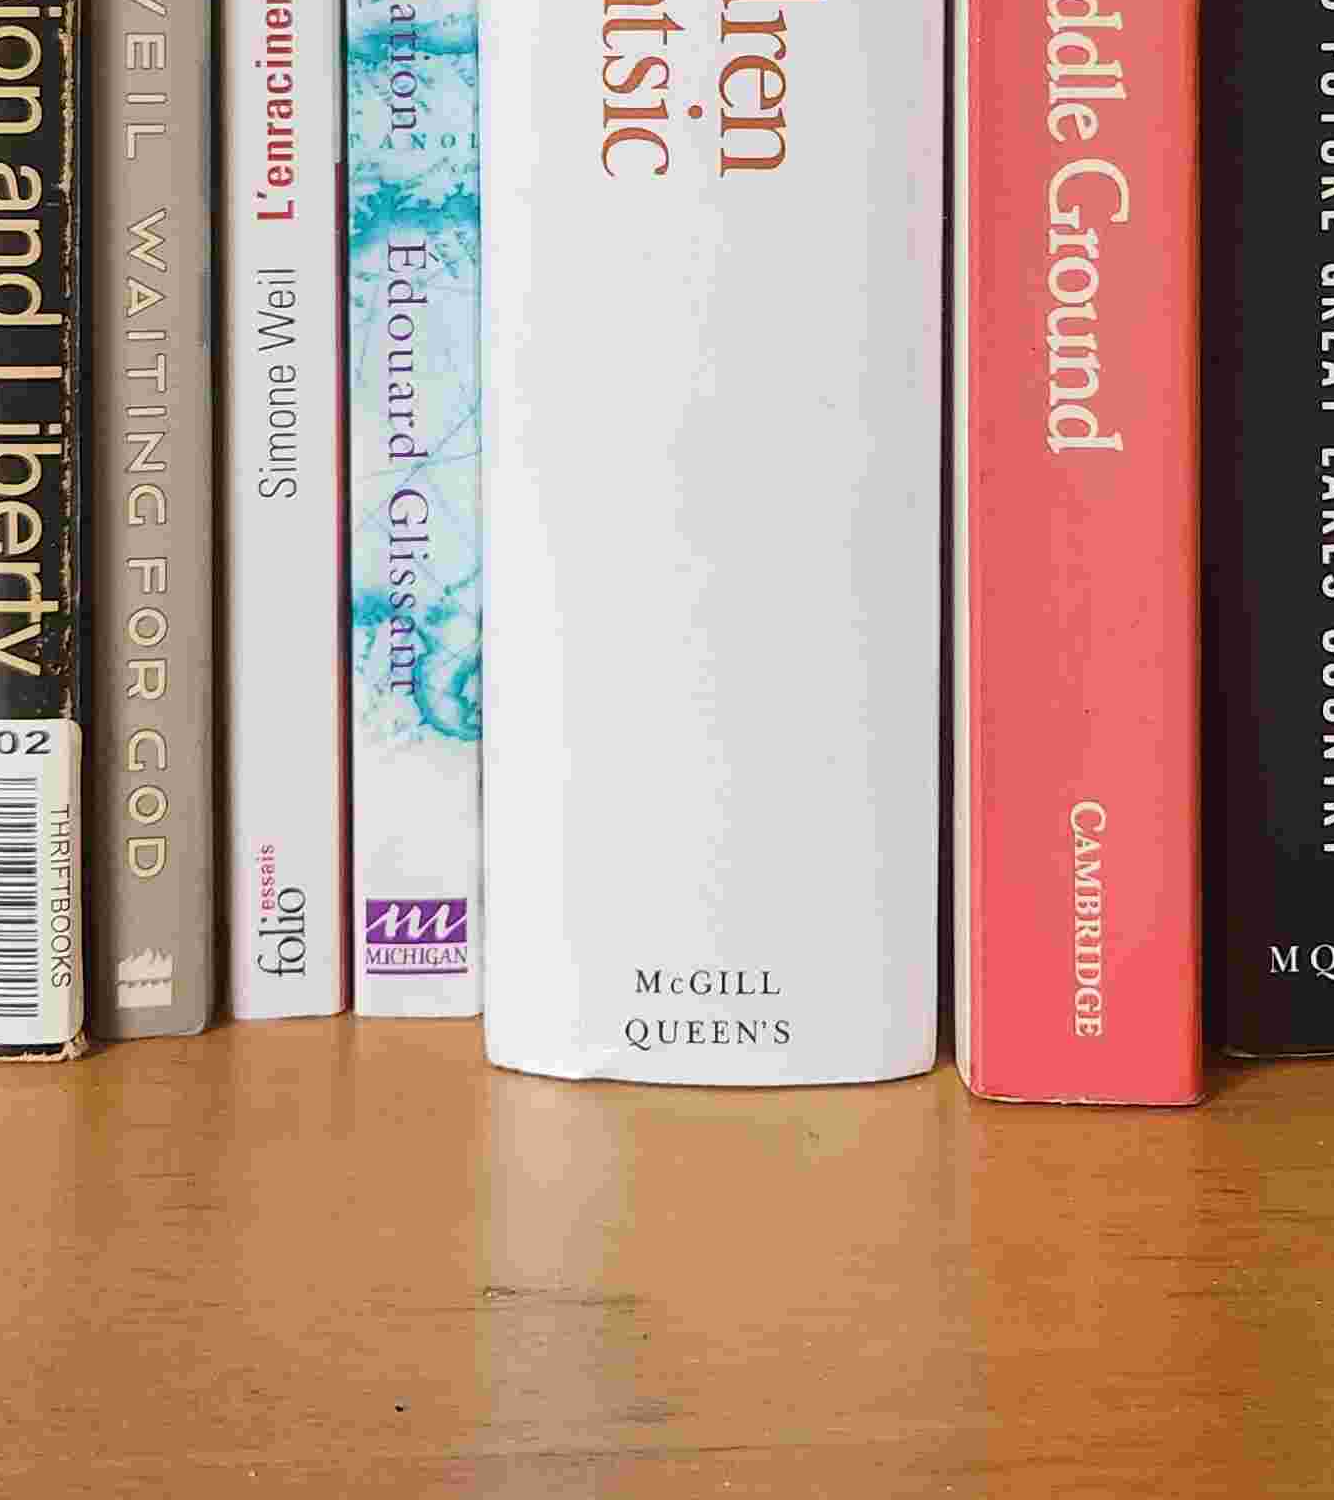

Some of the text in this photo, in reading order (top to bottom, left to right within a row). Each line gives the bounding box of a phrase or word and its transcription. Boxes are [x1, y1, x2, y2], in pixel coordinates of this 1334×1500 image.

[259, 269, 297, 498] Simone Weil
[1046, 158, 1130, 453] Ground
[125, 207, 168, 879] WAITING FOR GOD
[387, 240, 436, 697] Édouard Glissant
[50, 804, 71, 989] THRIFTBOOKS
[255, 844, 275, 910] essais
[257, 887, 306, 977] folio
[366, 947, 467, 965] MICHIGAN
[1068, 801, 1107, 1038] CAMBRIDGE
[626, 1019, 791, 1048] QUEEN'S
[635, 968, 780, 996] McGILL
